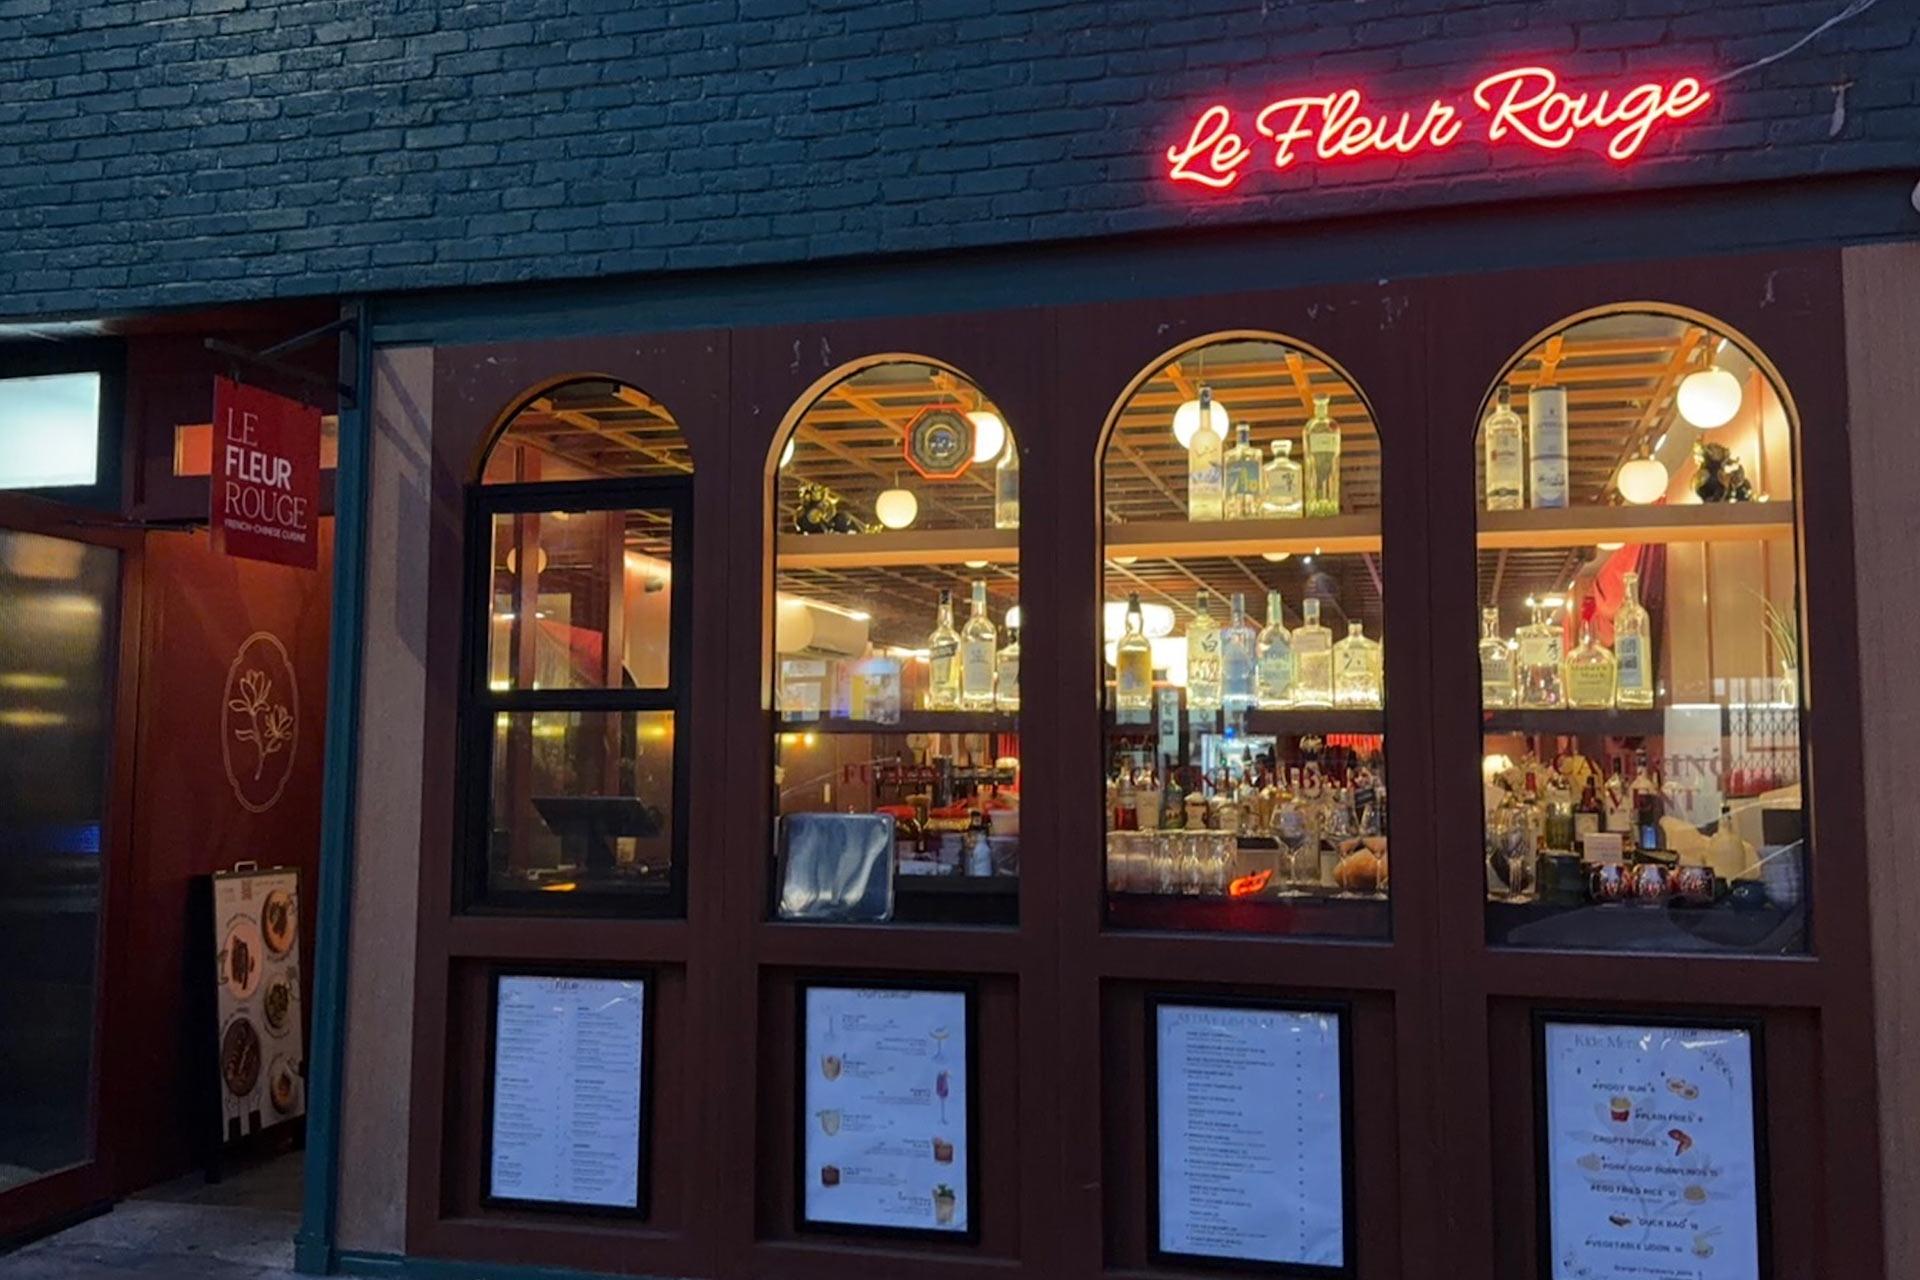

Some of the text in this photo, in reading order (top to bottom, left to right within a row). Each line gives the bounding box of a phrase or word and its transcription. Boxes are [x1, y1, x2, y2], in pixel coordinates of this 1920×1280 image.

[1168, 66, 1711, 188] Le Fleur Rouge
[226, 407, 260, 447] LE
[225, 444, 292, 491] FLEUR
[225, 481, 308, 530] ROUGE
